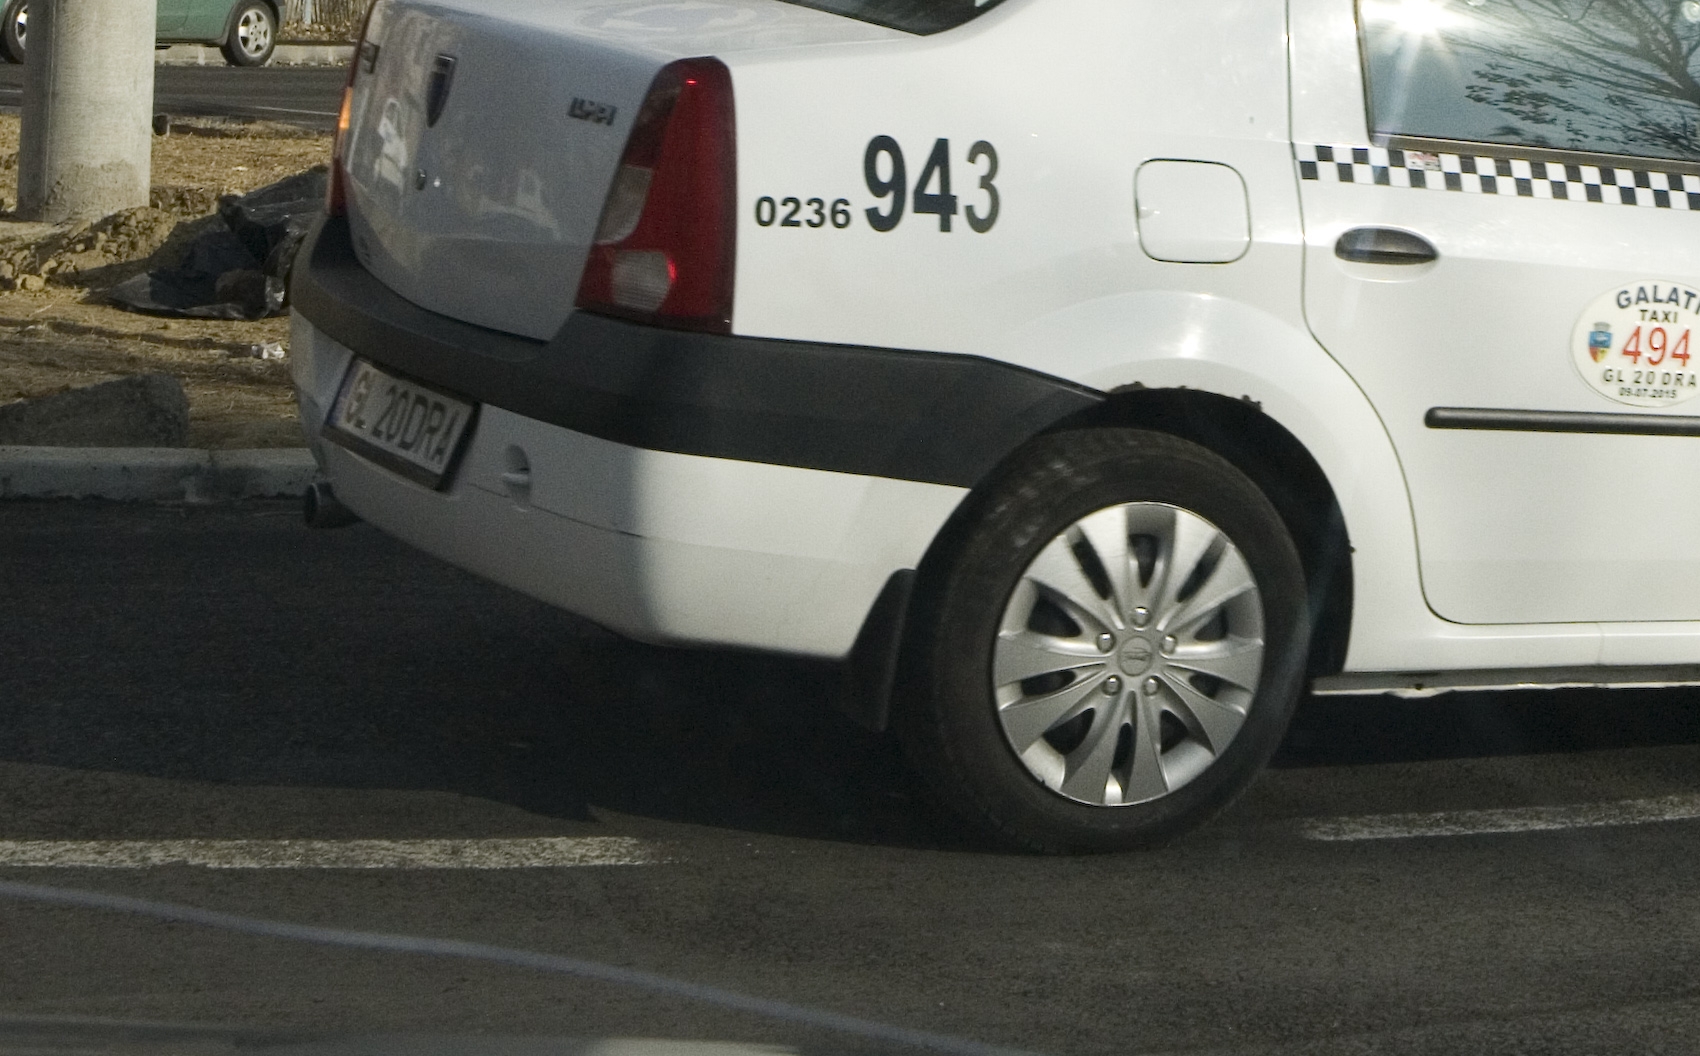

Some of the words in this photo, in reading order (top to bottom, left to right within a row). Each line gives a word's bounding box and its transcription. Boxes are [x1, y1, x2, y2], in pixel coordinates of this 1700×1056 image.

[755, 196, 851, 229] 0236
[864, 135, 1000, 234] 943
[1640, 309, 1678, 323] TAXI
[1622, 325, 1691, 367] 494
[1603, 369, 1625, 383] GL
